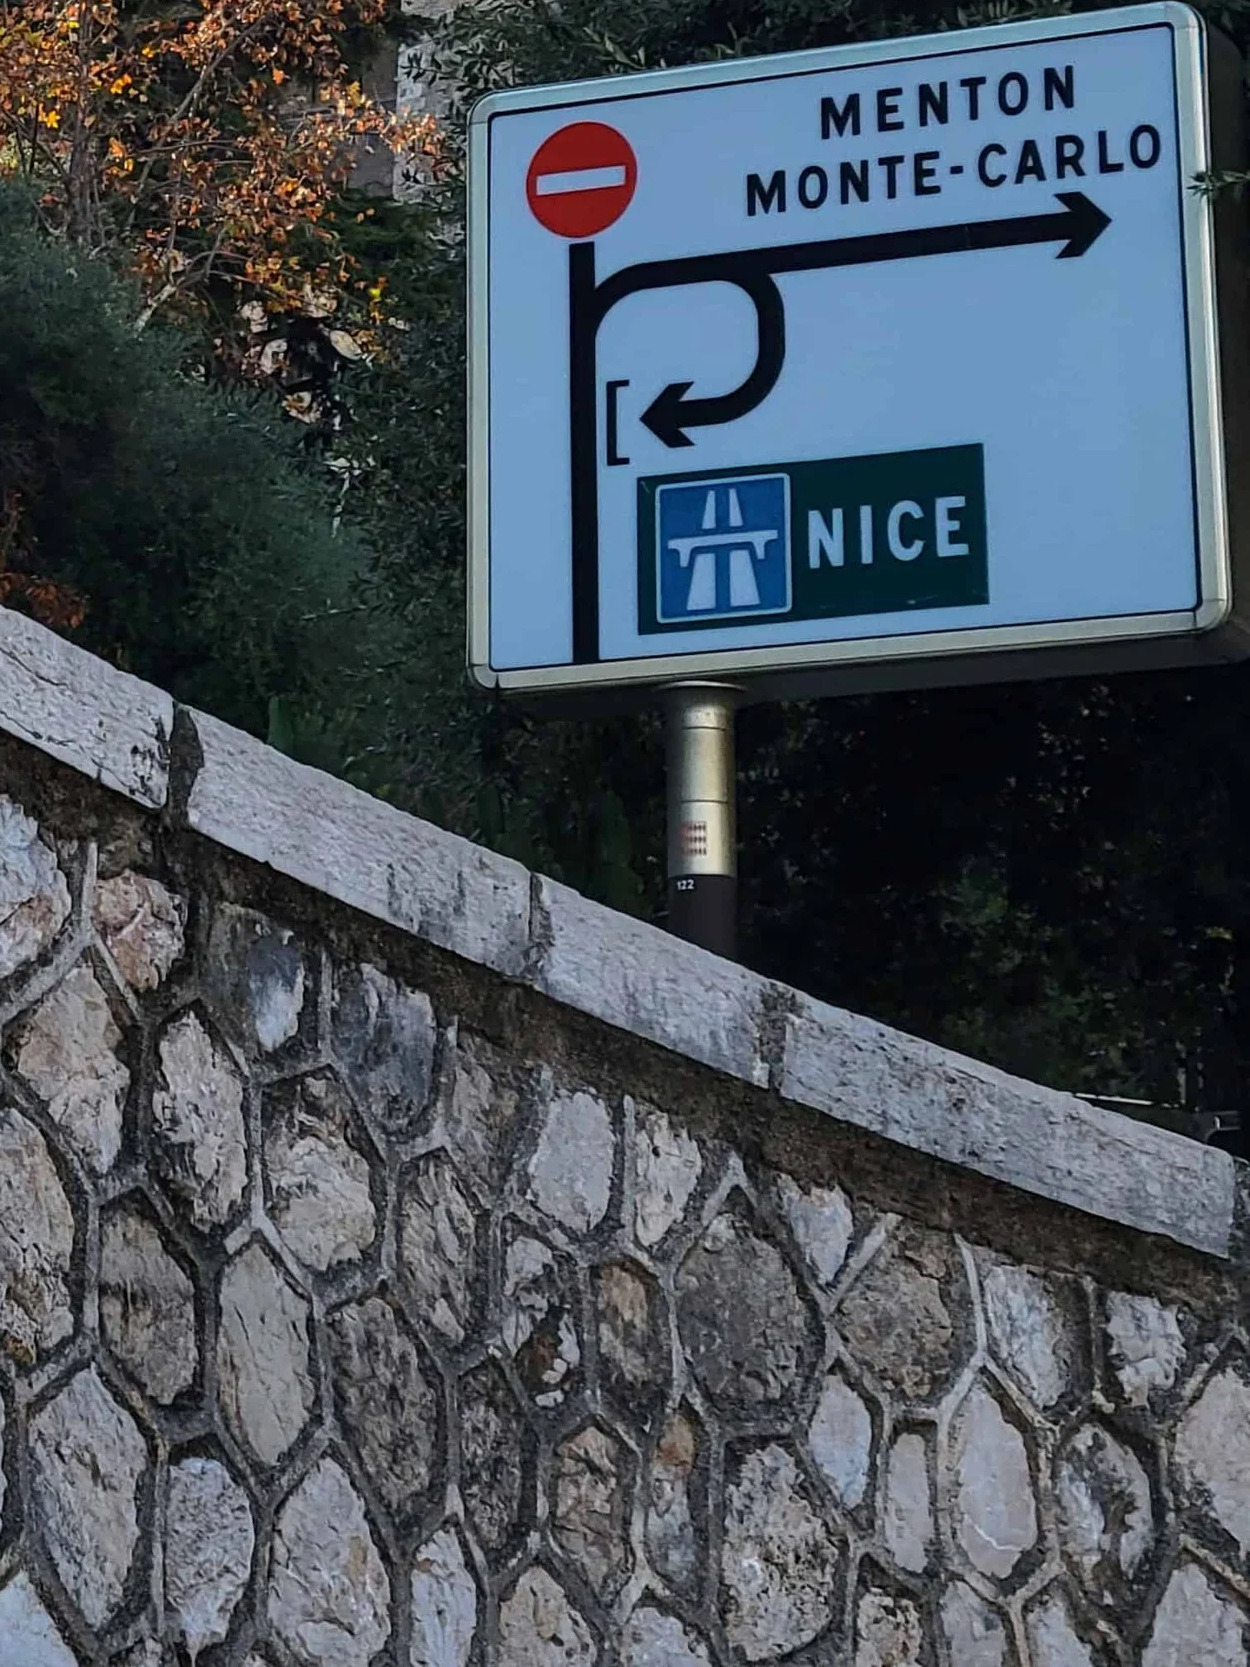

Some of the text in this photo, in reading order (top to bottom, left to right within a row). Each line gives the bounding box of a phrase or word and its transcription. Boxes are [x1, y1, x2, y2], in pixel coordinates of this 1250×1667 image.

[820, 64, 1075, 141] MENTON
[746, 123, 1162, 217] MONTE-CARLO
[807, 495, 969, 569] NICE
[677, 878, 695, 891] 122
